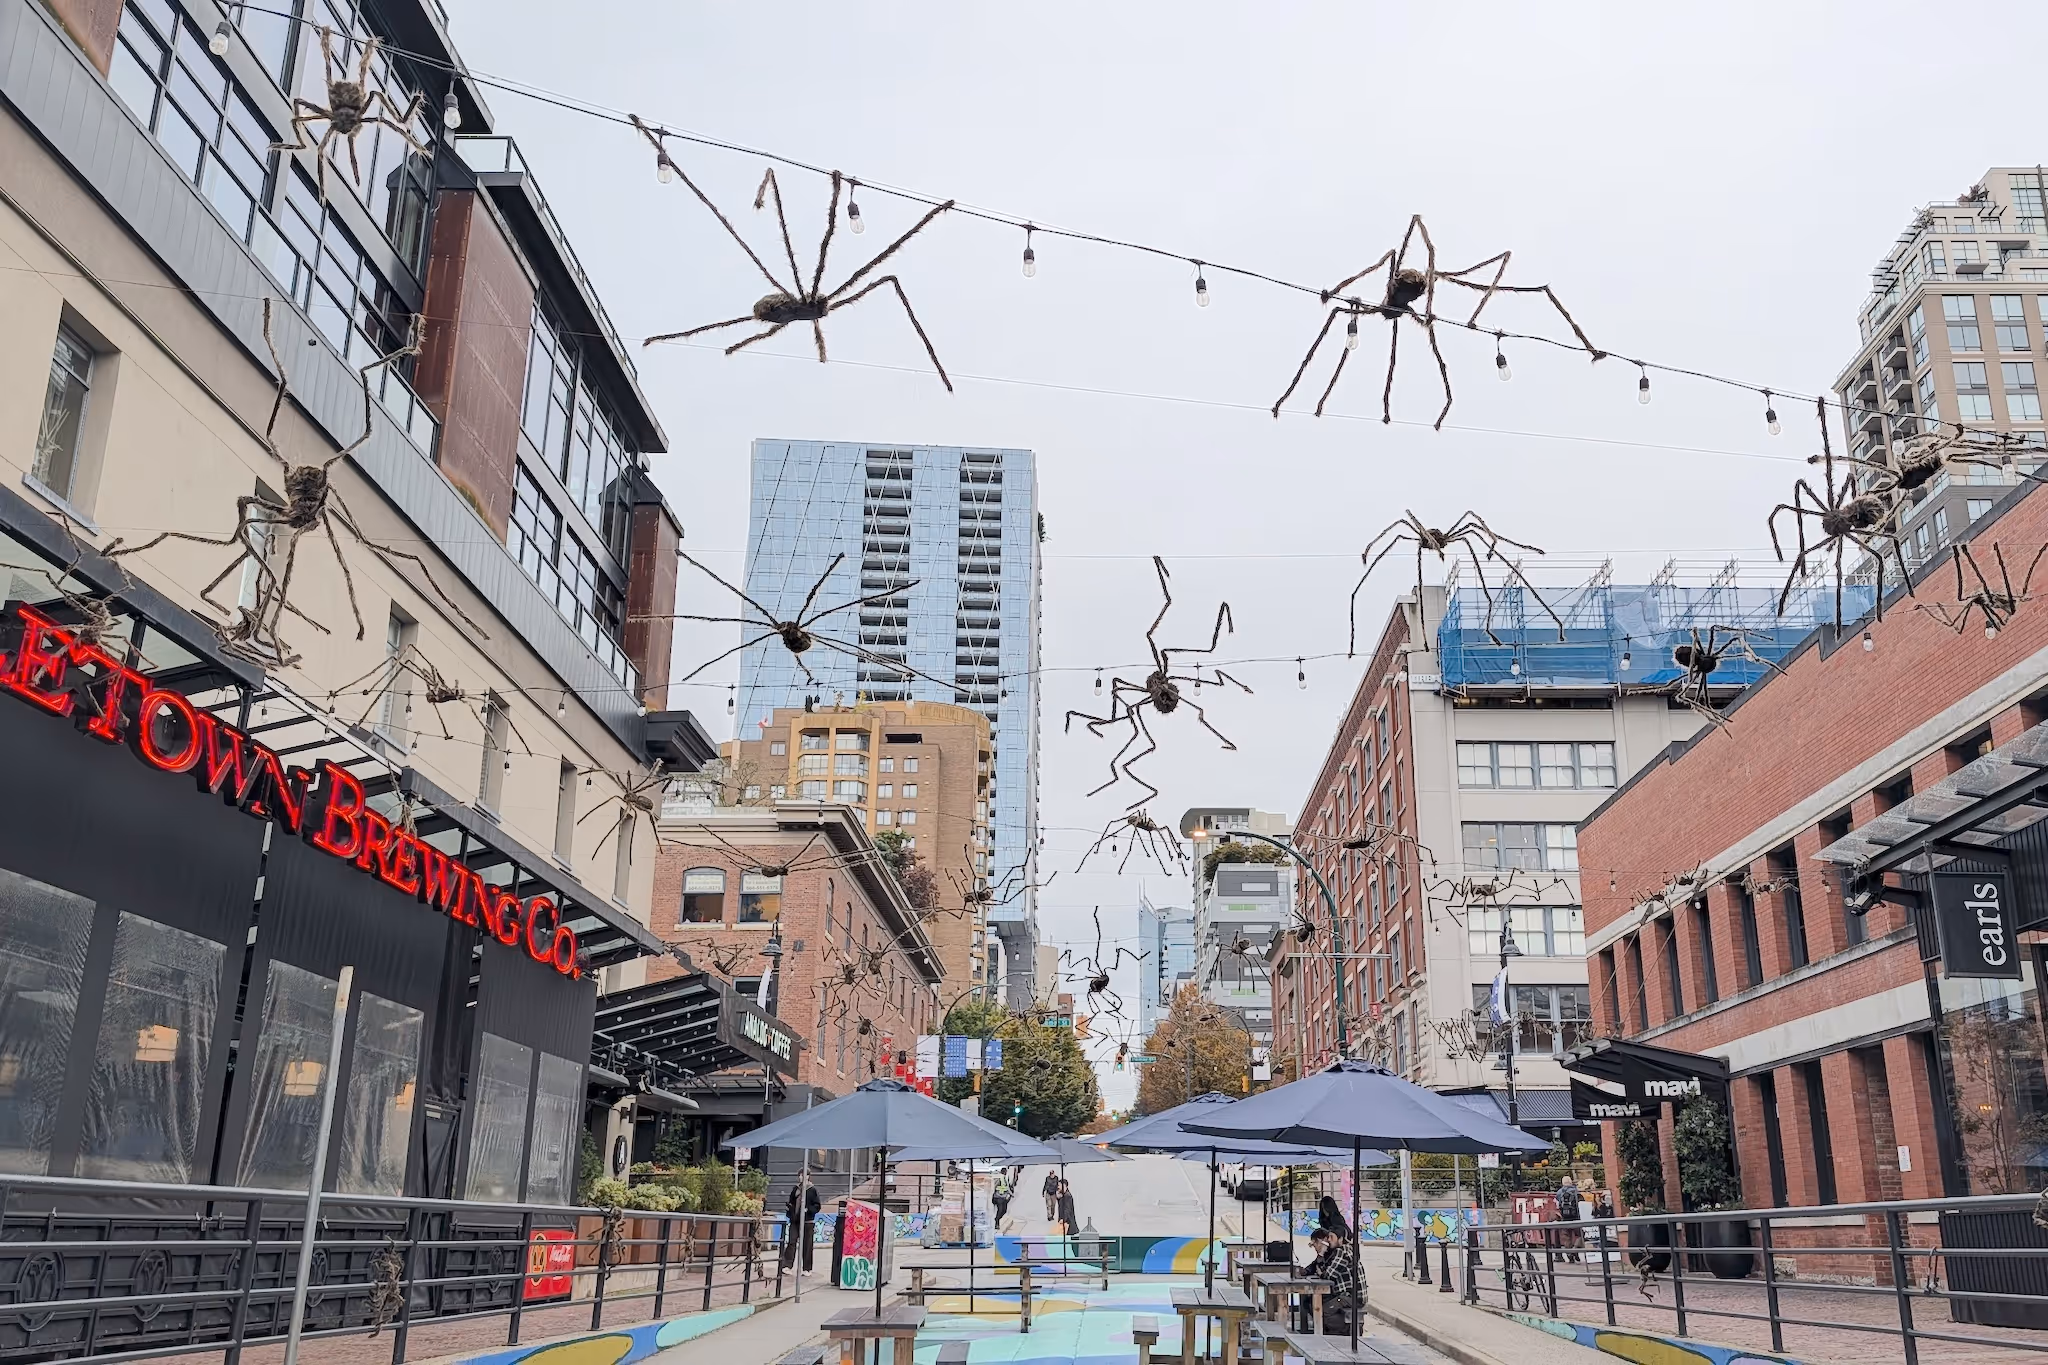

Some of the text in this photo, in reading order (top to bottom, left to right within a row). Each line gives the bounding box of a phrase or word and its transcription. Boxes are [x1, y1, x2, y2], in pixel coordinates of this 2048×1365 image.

[0, 600, 312, 834] ETOWN
[313, 760, 522, 947] BREWING
[1963, 882, 2007, 966] earls
[744, 1011, 791, 1061] ANALOG COFFEE
[1589, 1102, 1640, 1117] mavi
[1644, 1076, 1701, 1097] mavi
